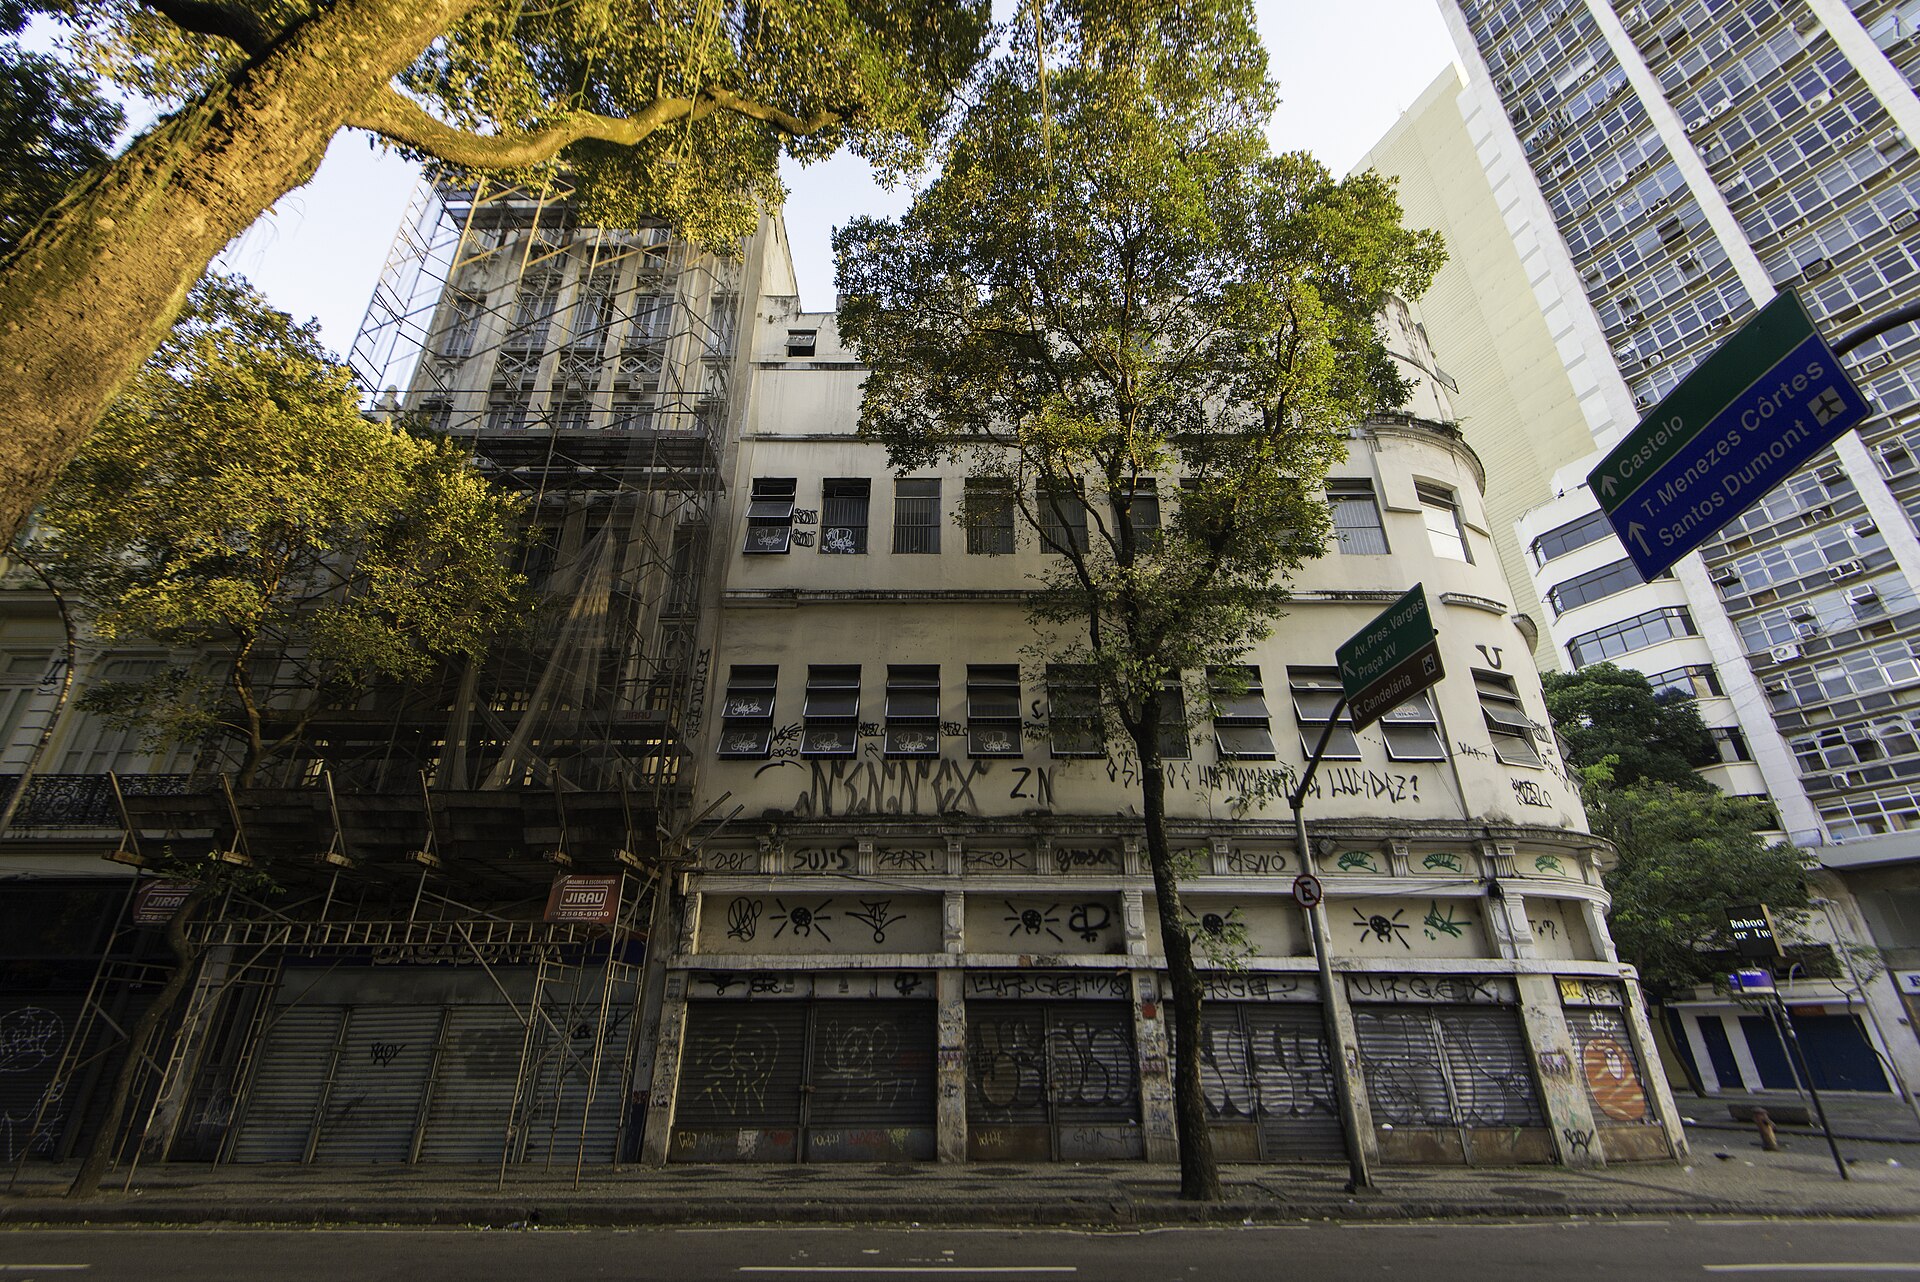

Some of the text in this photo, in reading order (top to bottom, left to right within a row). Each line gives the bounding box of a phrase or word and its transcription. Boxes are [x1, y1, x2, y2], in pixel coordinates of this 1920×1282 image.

[1618, 414, 1684, 479] Castelo
[1641, 359, 1825, 519] T. Menezes Côrtes
[1658, 419, 1811, 547] Santos Dumont
[1355, 598, 1425, 660] Av. Pres. Vargas
[1357, 641, 1397, 680] Praça XV
[1363, 673, 1413, 713] Candelária
[565, 892, 605, 903] JIRAU
